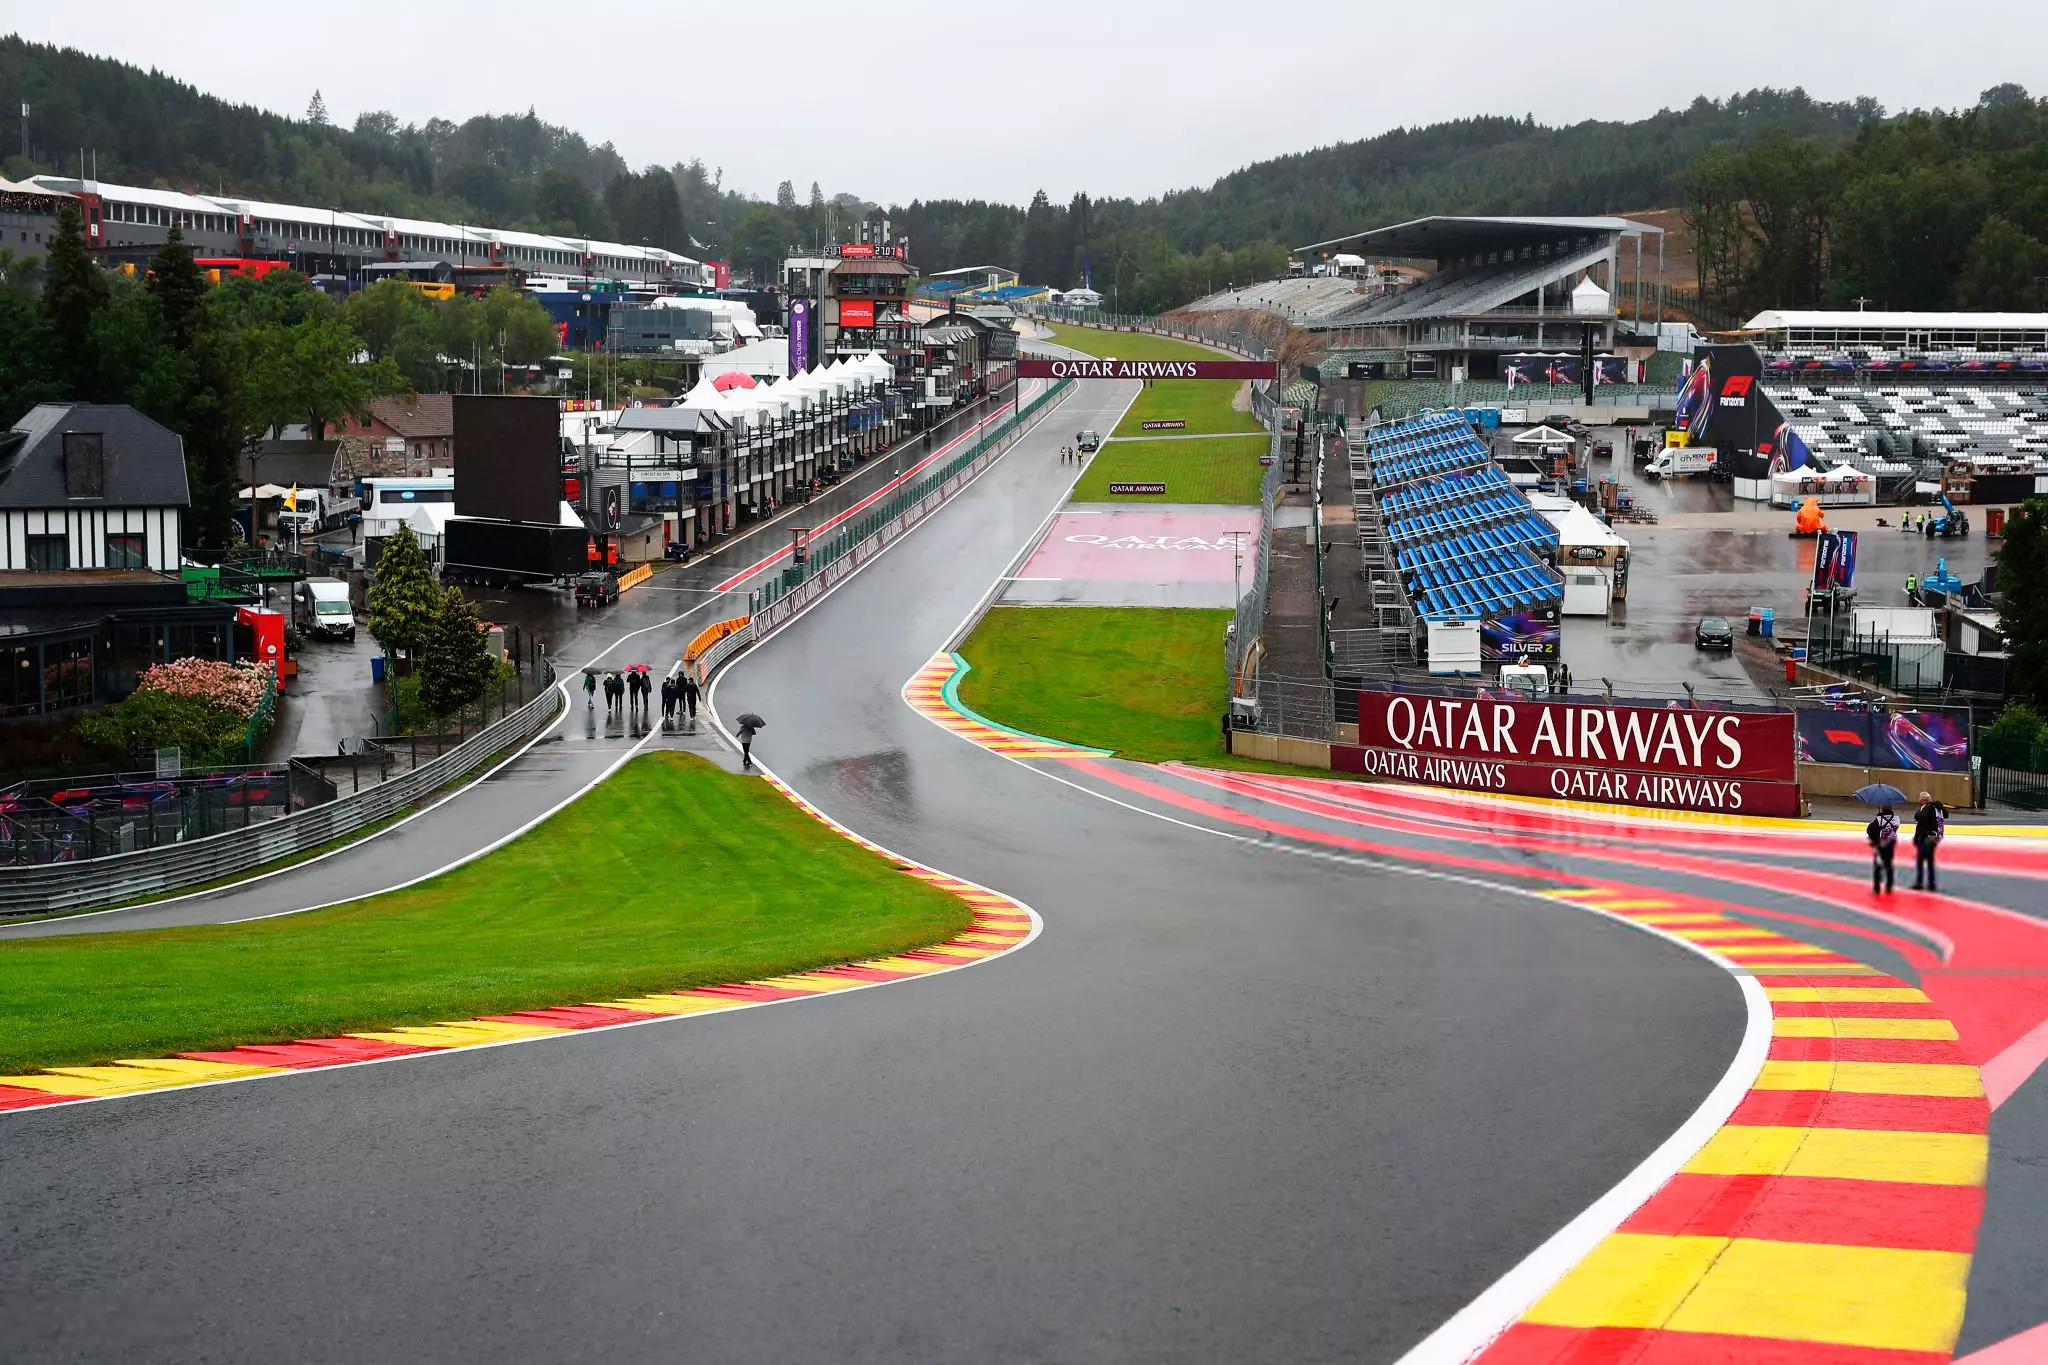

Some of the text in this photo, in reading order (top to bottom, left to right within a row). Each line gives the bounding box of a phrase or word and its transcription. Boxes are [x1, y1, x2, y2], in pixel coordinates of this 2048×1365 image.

[1051, 361, 1197, 377] QATAR AIRWAYS
[1111, 485, 1134, 493] QATAR
[1065, 534, 1246, 545] QATAR
[791, 586, 807, 612] QATAR
[755, 598, 790, 637] QATAR AIRWAYS
[1501, 643, 1553, 653] SILVER 2
[1386, 697, 1742, 769] QATAR AIRWAYS
[1364, 749, 1505, 788] QATAR AIRWAYS
[1551, 769, 1742, 809] QATAR AIRWAYS
